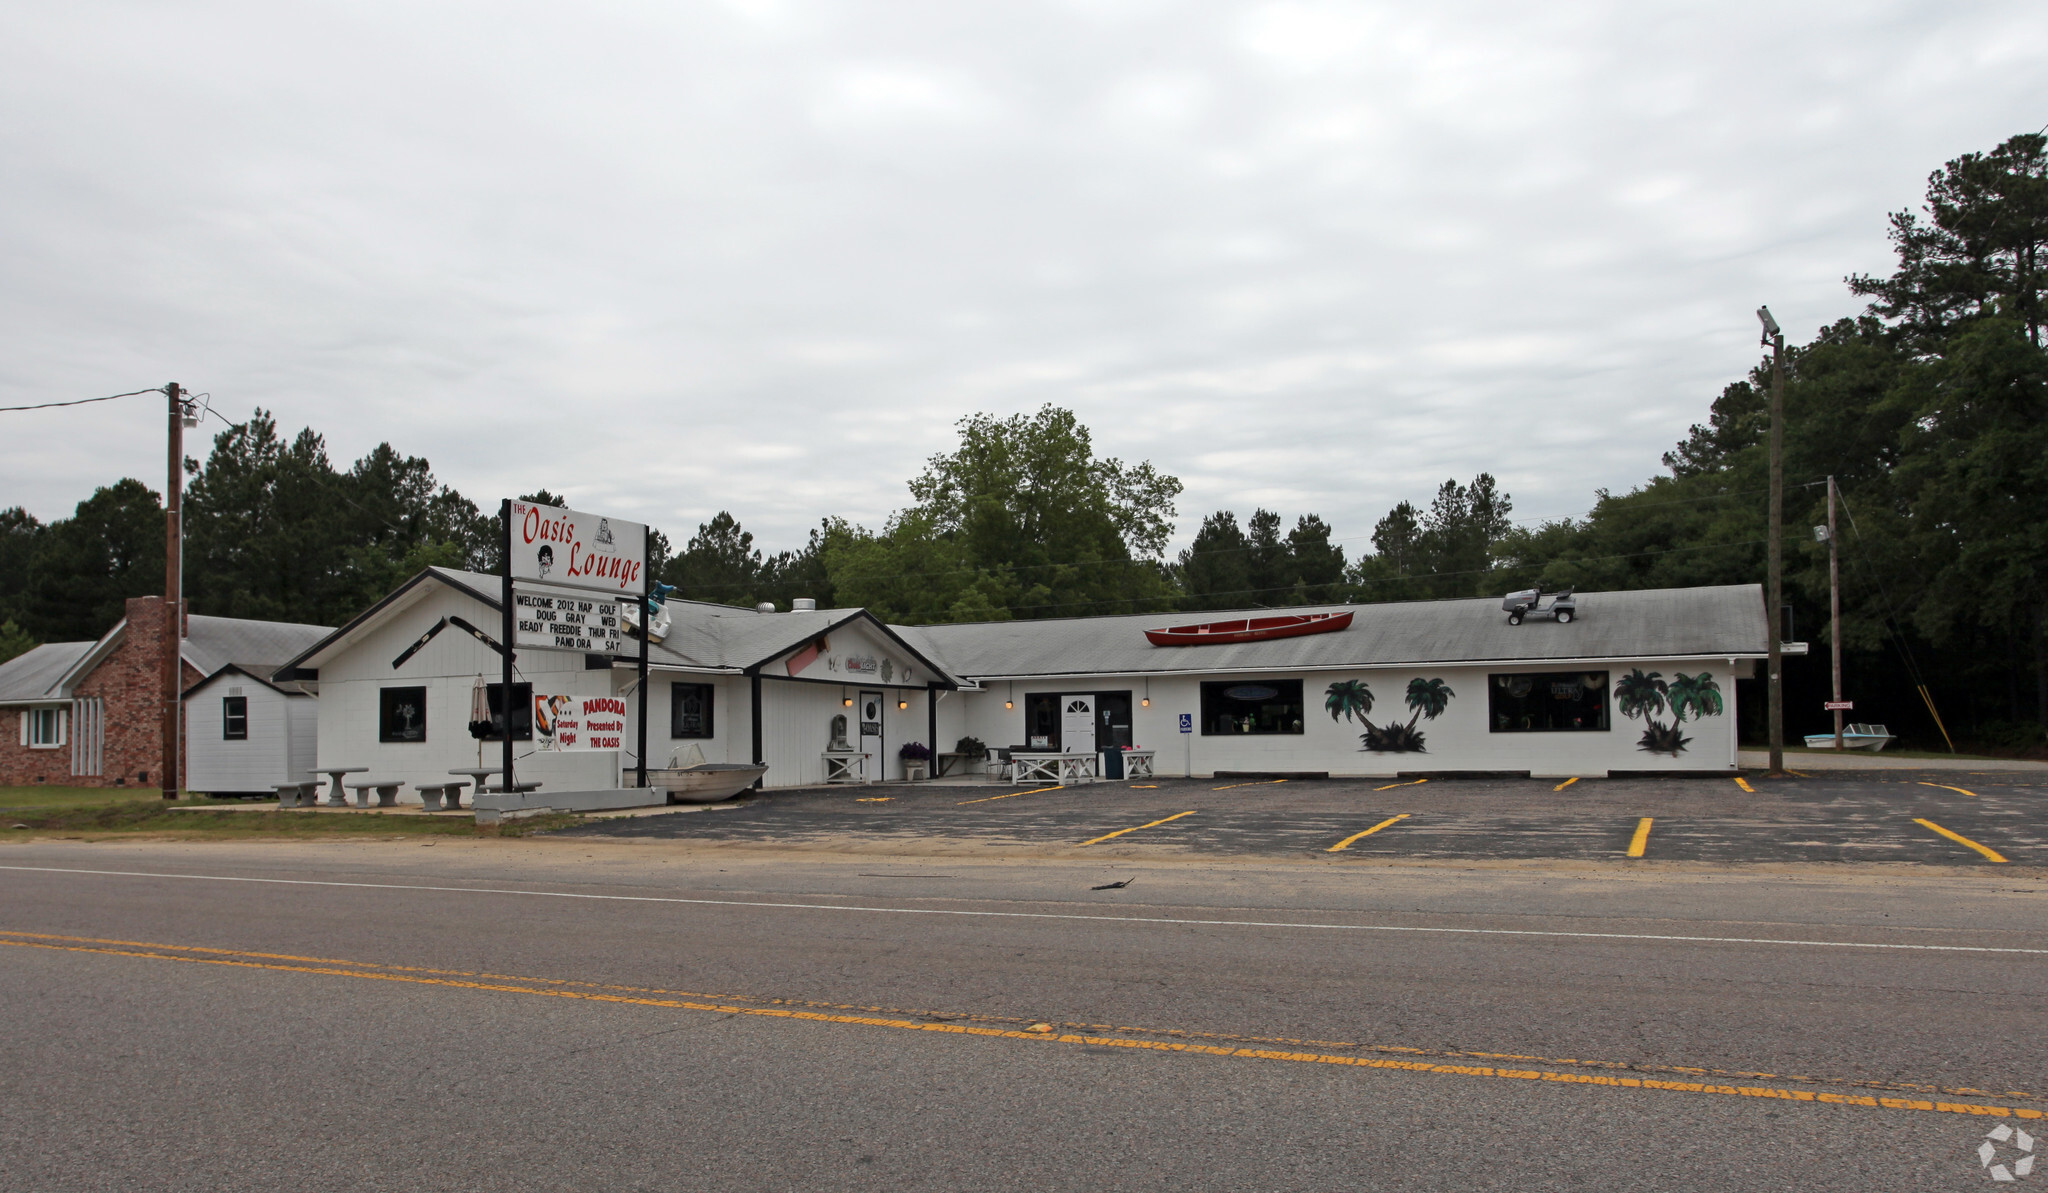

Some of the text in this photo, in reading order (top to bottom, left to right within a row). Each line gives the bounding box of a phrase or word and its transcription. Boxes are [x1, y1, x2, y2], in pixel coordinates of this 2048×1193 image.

[514, 503, 526, 515] THE
[523, 506, 575, 544] Oasis
[567, 541, 641, 588] Lounge
[517, 595, 616, 615] WELCOME 2012 HAP GOLF
[537, 610, 616, 627] DOUG GRAY WED
[519, 621, 619, 639] READY FREEDDIE THUR FRI
[605, 641, 620, 651] SAT
[583, 698, 626, 717] PANDORA
[557, 720, 579, 730] Saturday
[587, 720, 623, 733] Presented By
[560, 732, 577, 746] Night
[590, 737, 620, 748] THE OASIS
